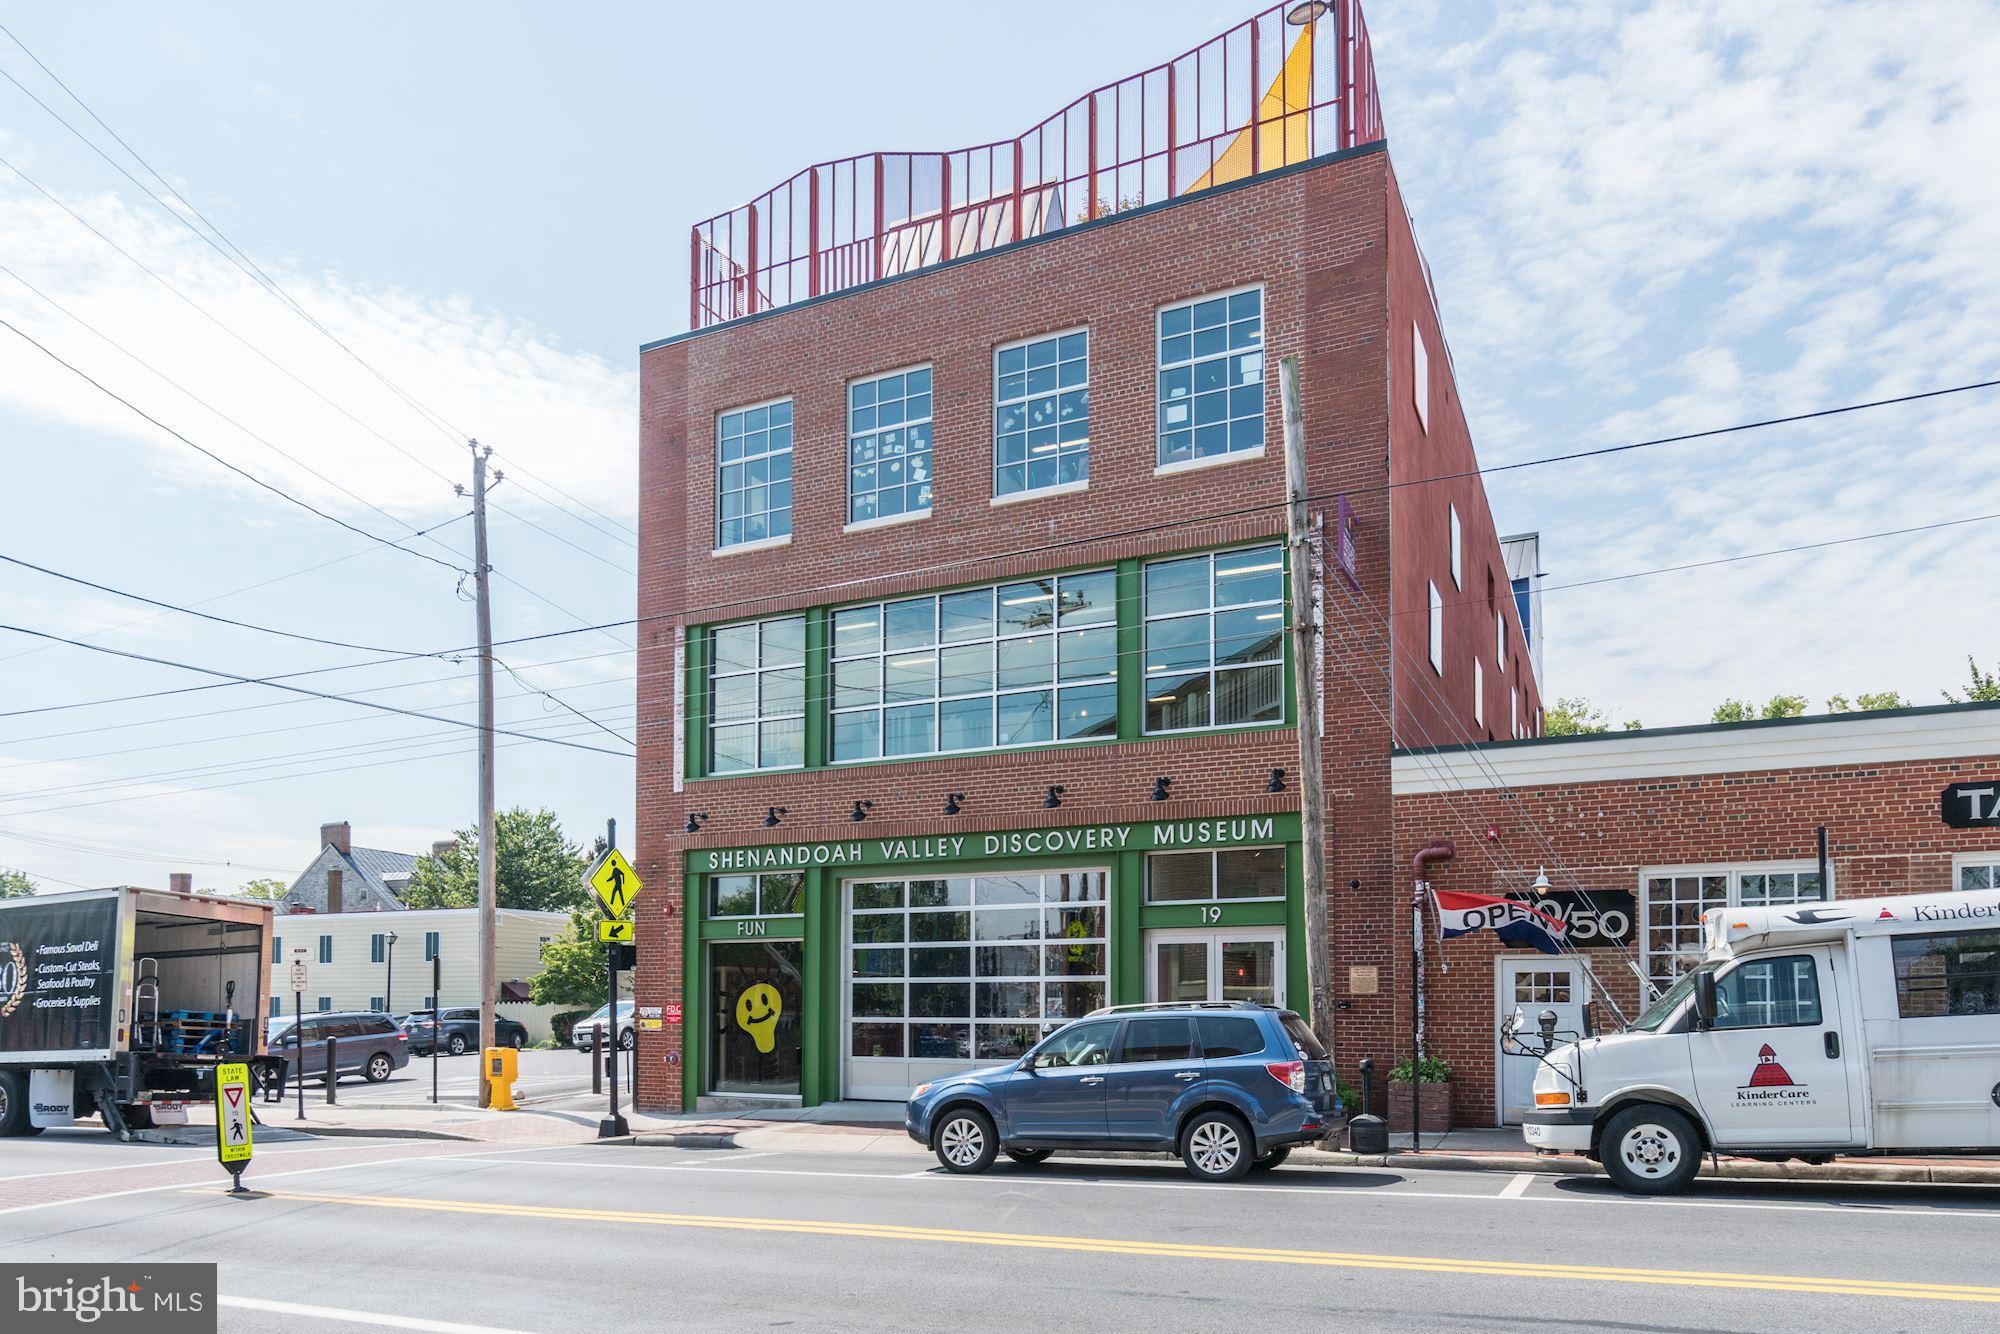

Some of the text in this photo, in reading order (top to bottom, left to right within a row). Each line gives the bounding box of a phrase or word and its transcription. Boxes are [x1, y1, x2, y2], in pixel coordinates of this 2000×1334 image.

[708, 818, 1274, 870] SHENANDOAH VALLEY DISCOVERY MUSEUM
[1200, 907, 1222, 924] 19
[1912, 903, 2000, 922] Kinder
[737, 921, 765, 936] FUN
[40, 940, 99, 955] Famous Saval Deli
[38, 960, 101, 974] Custom-Cut Steaks,
[37, 976, 95, 990] Seafood & Poultry
[36, 995, 101, 1008] Groceries & Supplies
[1737, 1089, 1809, 1100] KinderCare
[34, 1103, 70, 1112] BRODY
